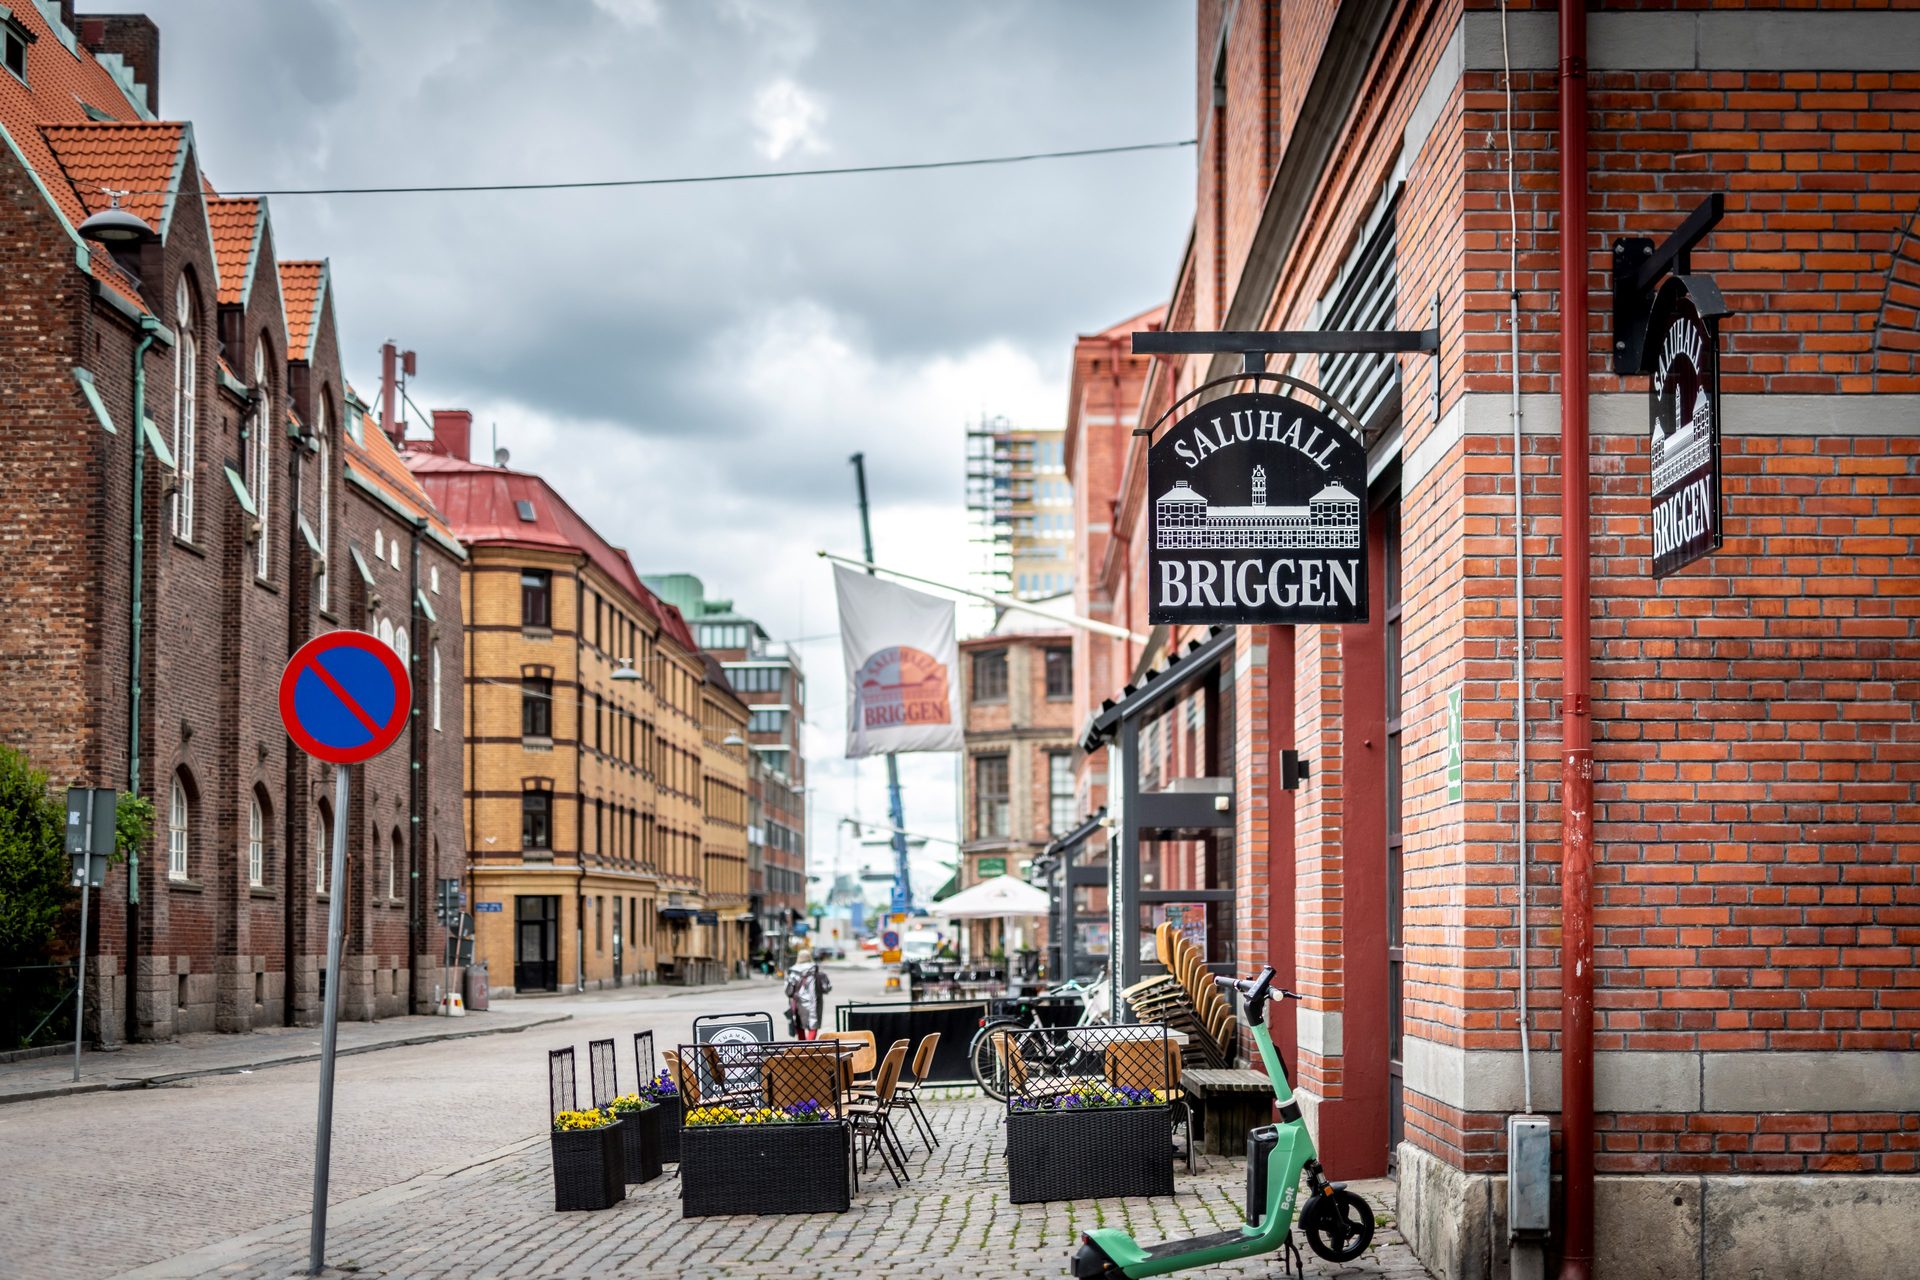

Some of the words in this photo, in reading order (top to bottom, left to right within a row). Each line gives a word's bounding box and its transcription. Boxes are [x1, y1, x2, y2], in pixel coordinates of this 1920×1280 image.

[1654, 317, 1703, 401] SALUHALL
[1174, 409, 1341, 471] SALUHALL
[1653, 474, 1711, 560] BRIGGEN
[1158, 558, 1360, 608] BRIGGEN
[864, 700, 944, 727] BRIGGEN
[1280, 1186, 1295, 1211] Bolt
